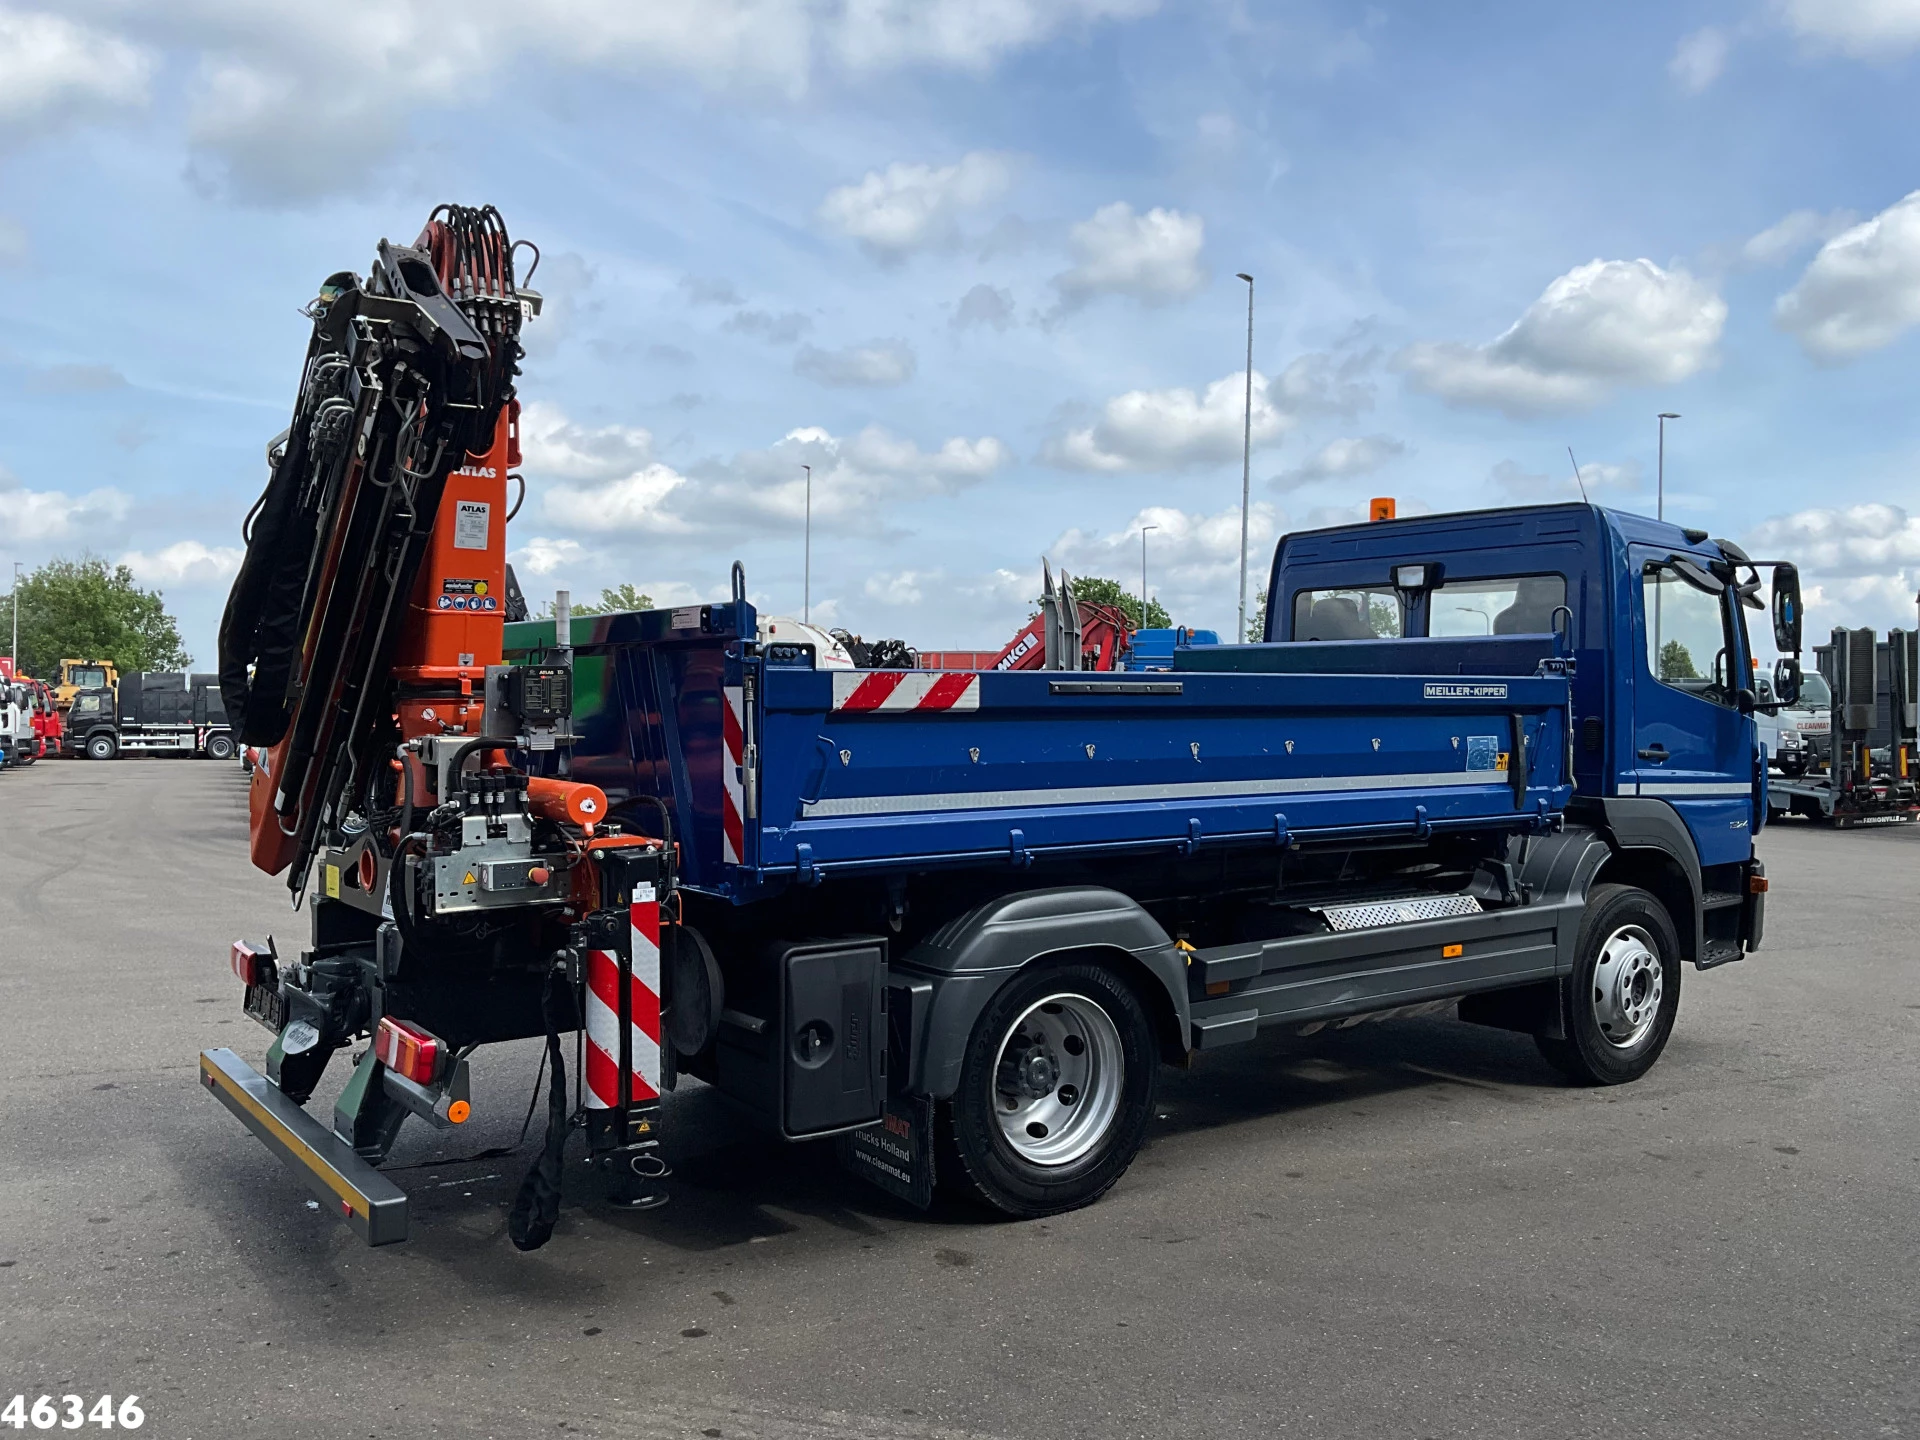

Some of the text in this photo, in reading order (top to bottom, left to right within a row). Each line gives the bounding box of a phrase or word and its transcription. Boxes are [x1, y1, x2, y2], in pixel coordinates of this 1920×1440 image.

[461, 505, 486, 513] ATLAS
[998, 642, 1028, 670] MKG
[1426, 686, 1506, 696] MEILLER-KIPPER
[1796, 722, 1830, 730] CLEANMAT
[881, 1137, 910, 1162] Holland
[856, 1149, 911, 1184] www.cleanmat.eu
